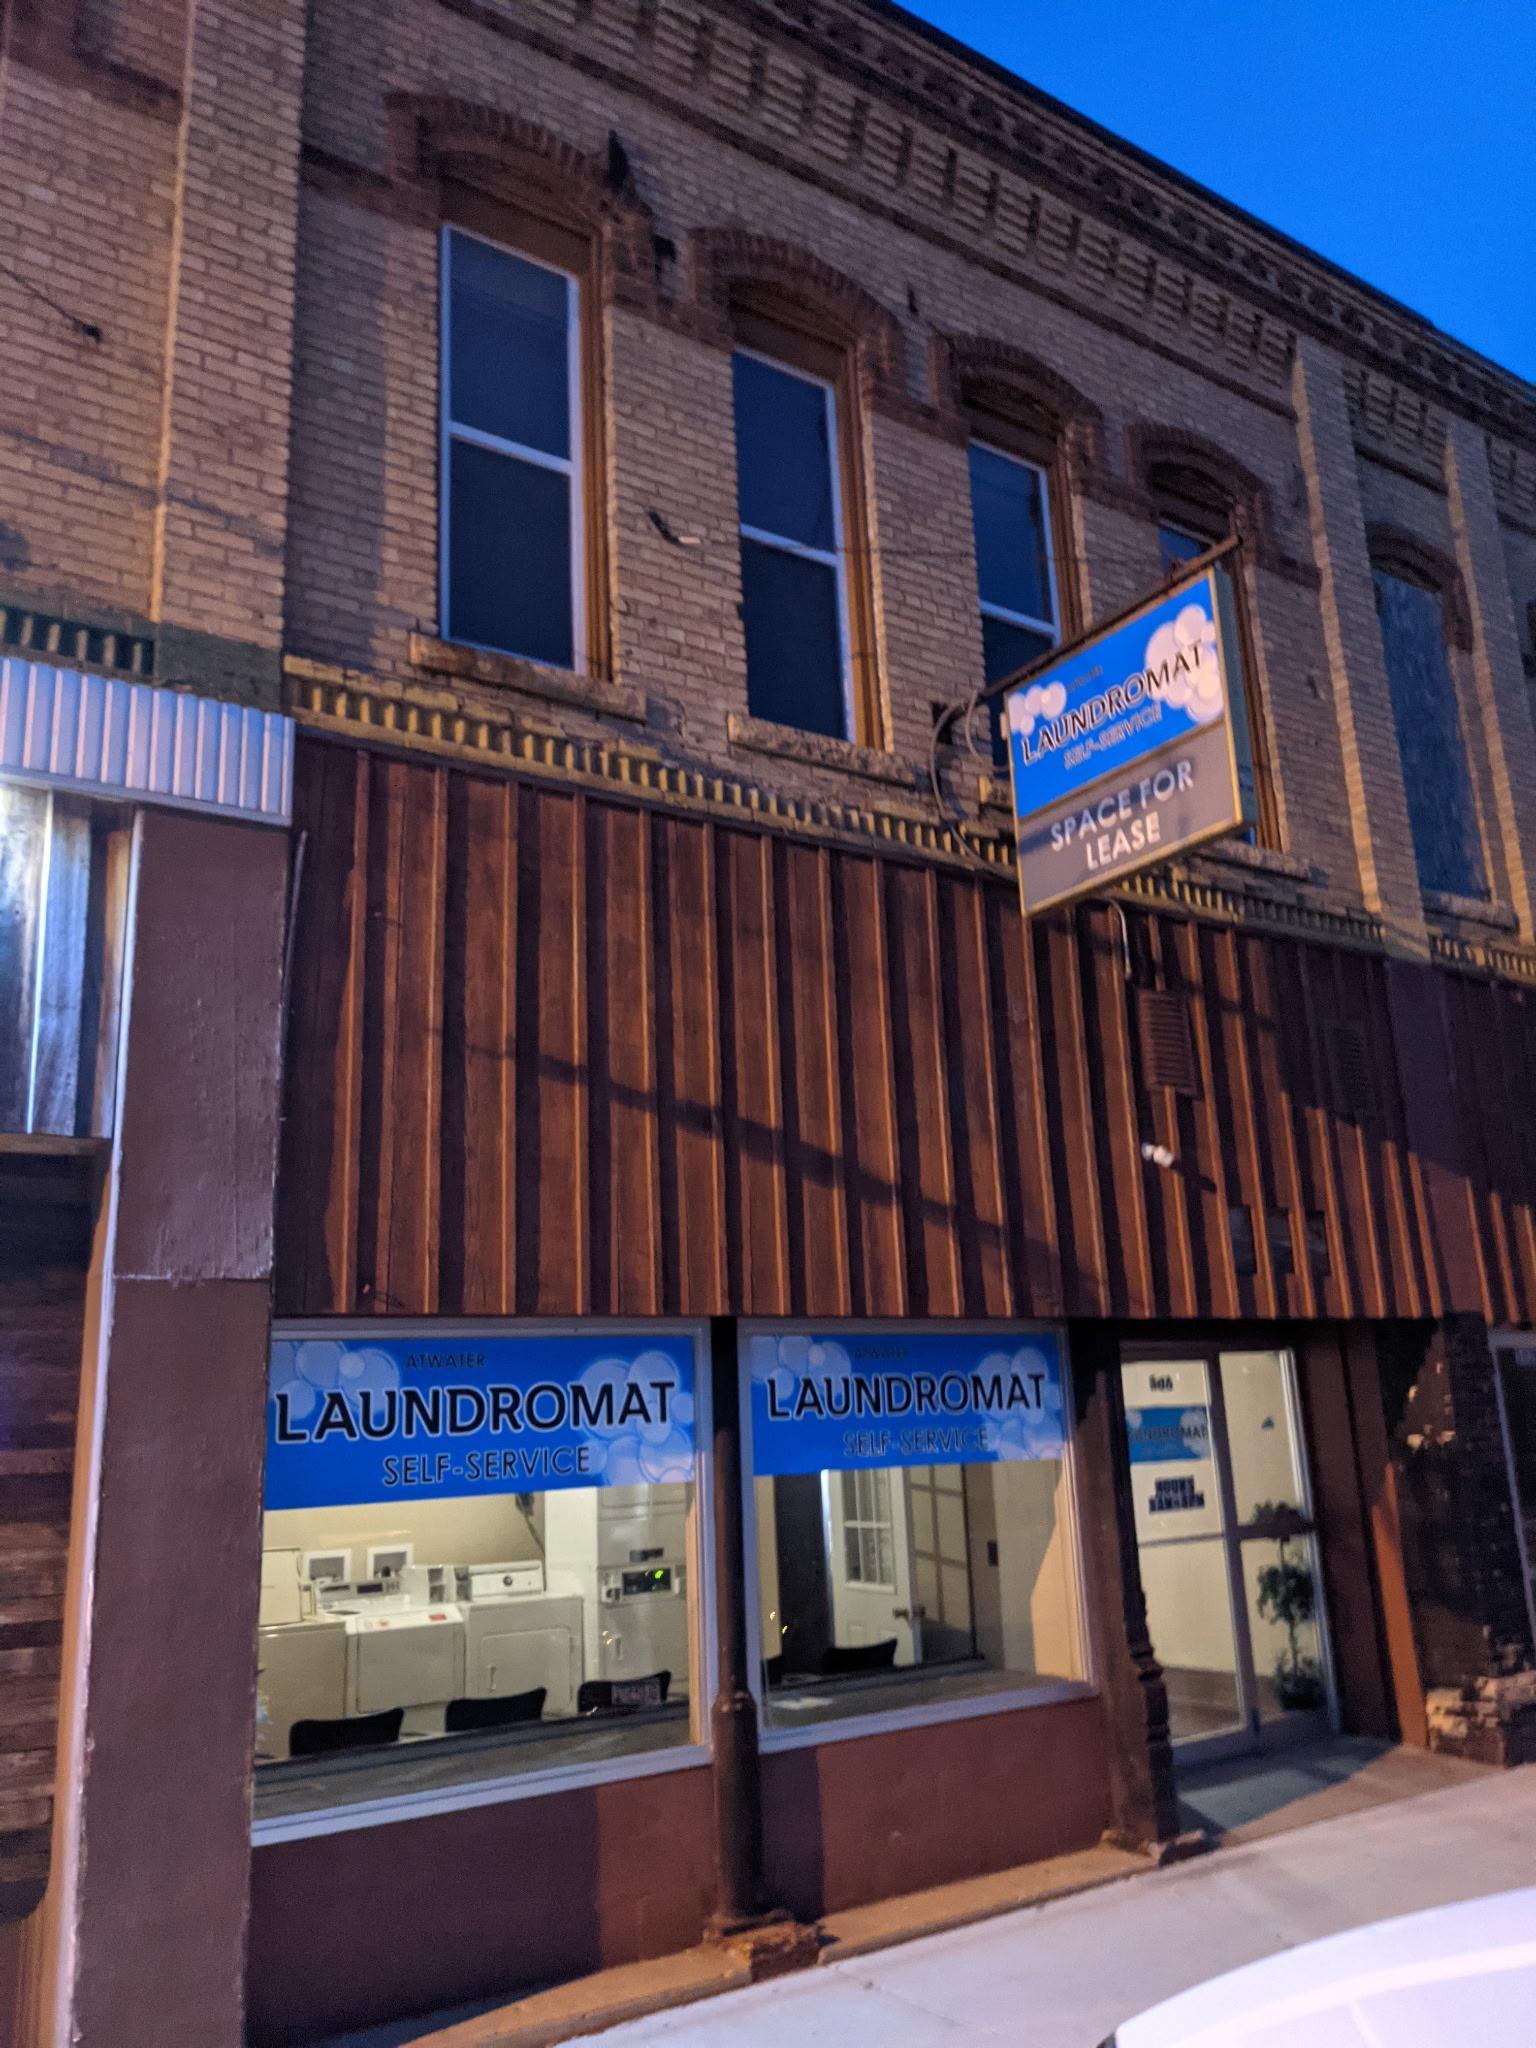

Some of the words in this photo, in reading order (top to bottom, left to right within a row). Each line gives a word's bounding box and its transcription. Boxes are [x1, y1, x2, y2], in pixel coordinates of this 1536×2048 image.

[1021, 639, 1202, 766] LAUNDROMAT
[1051, 787, 1133, 851] SPACE
[1139, 759, 1194, 815] FOR
[1086, 811, 1161, 870] LEASE
[406, 1353, 485, 1369] ATWATER
[274, 1381, 676, 1443] LAUNDROMAT
[767, 1373, 1046, 1419] LAUNDROMAT
[382, 1446, 591, 1487] SELF-SERVICE
[843, 1427, 988, 1457] SELF-SERVICE
